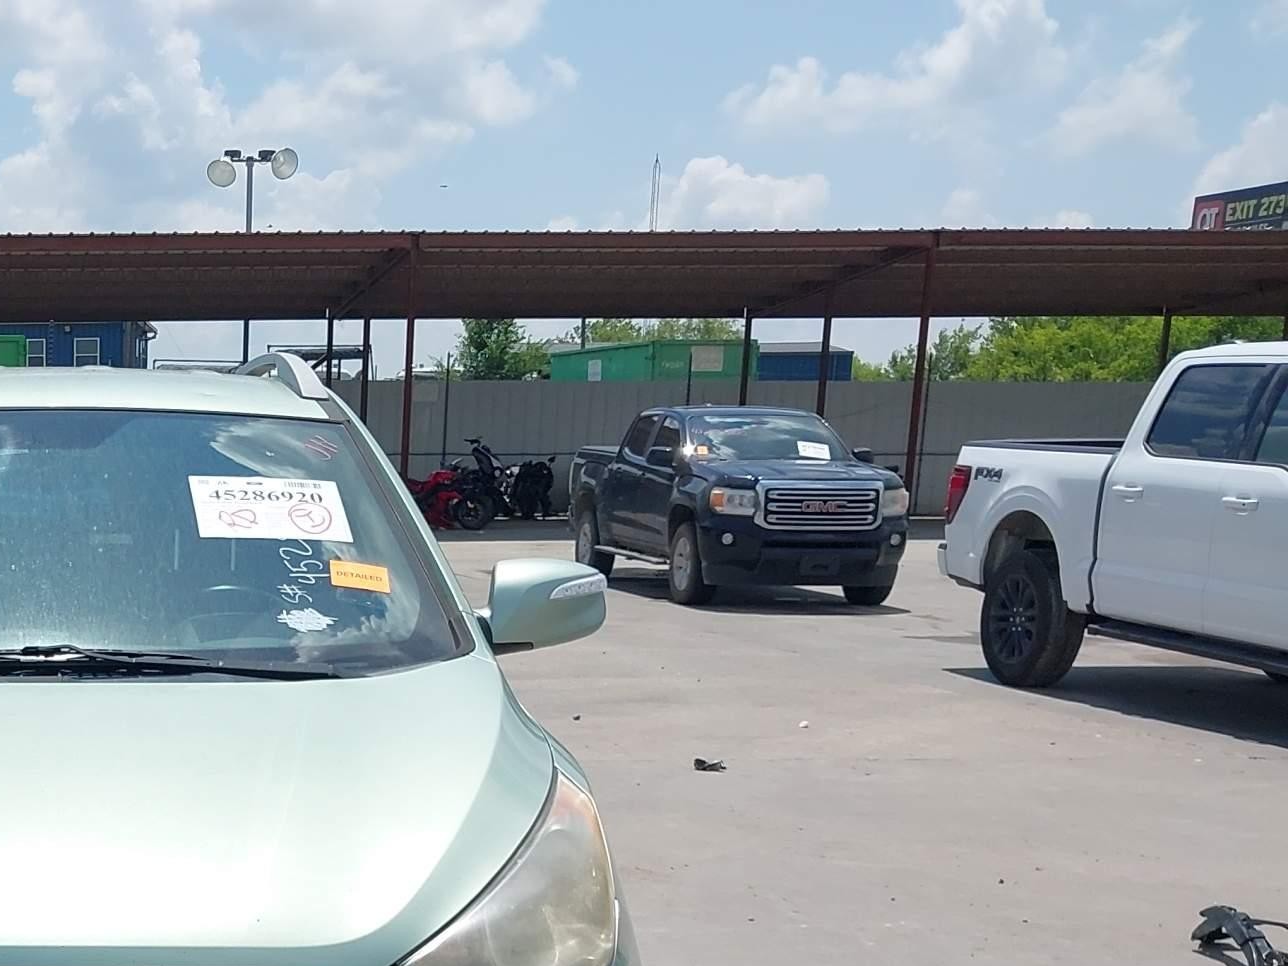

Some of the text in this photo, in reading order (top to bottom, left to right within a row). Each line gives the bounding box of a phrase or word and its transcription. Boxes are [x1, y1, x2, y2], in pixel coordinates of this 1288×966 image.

[1225, 194, 1286, 222] EXIT 273
[1197, 207, 1219, 230] QT
[974, 467, 1003, 480] FX4
[208, 488, 323, 504] 45286920
[801, 501, 848, 512] GMC
[335, 569, 383, 583] DETAILED
